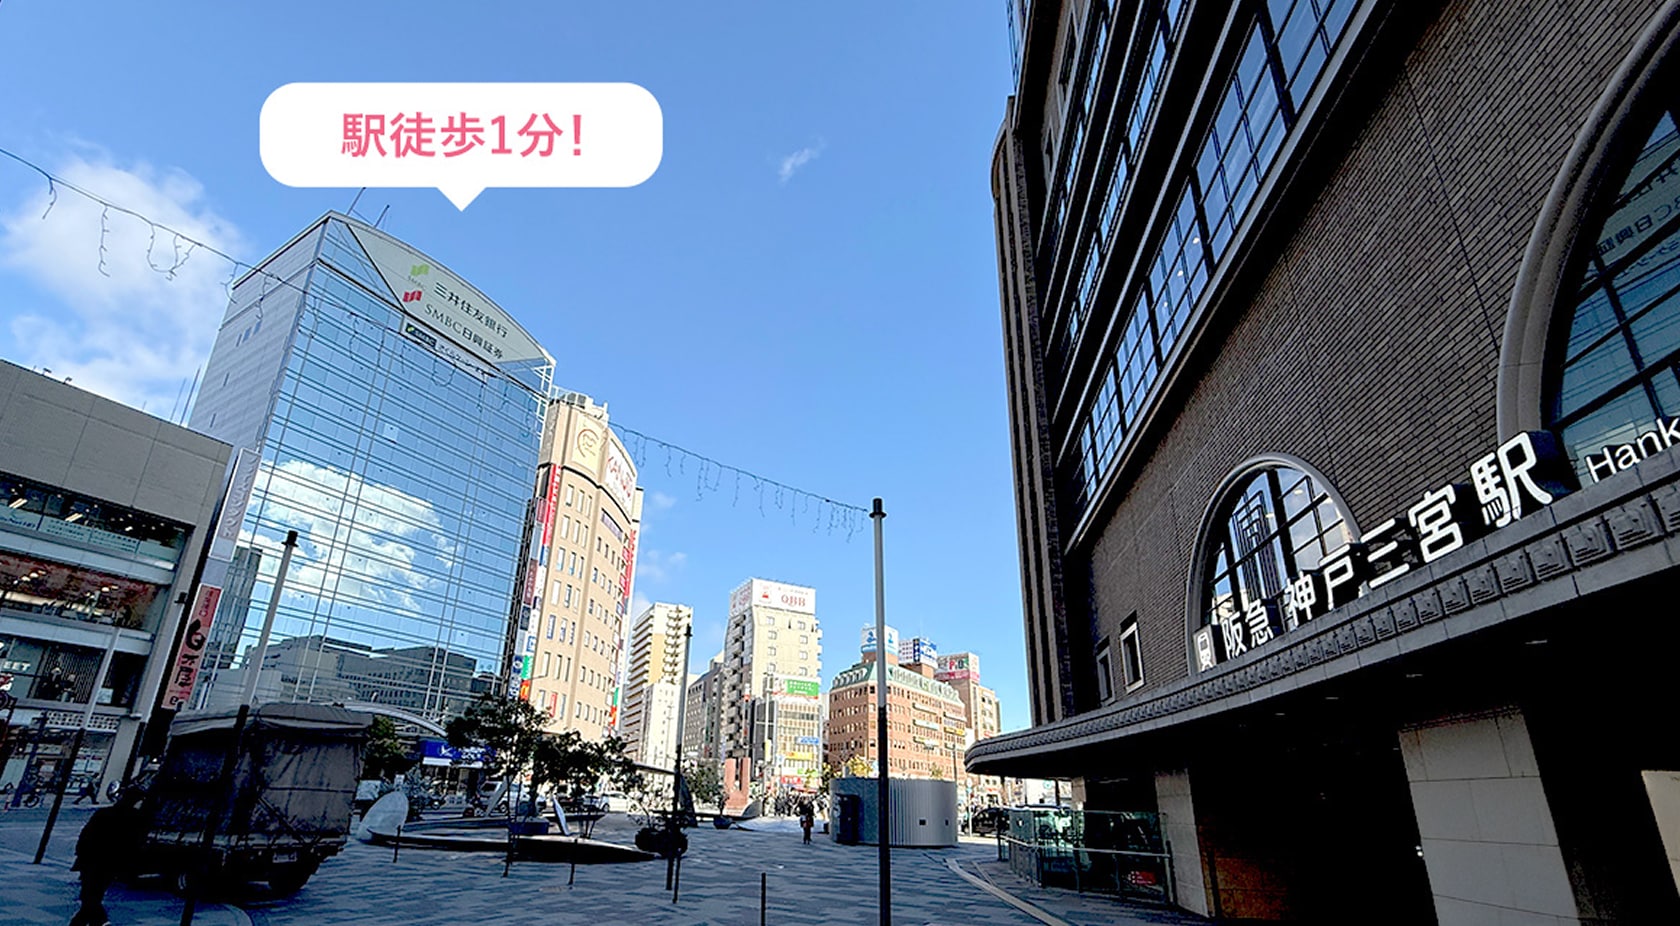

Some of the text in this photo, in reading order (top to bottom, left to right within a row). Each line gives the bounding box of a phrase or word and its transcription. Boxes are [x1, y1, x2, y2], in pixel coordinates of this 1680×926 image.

[424, 304, 504, 359] SMBC日興証券
[434, 281, 508, 338] 三井住友銀行
[1585, 418, 1680, 483] Hank
[781, 594, 806, 607] QBB
